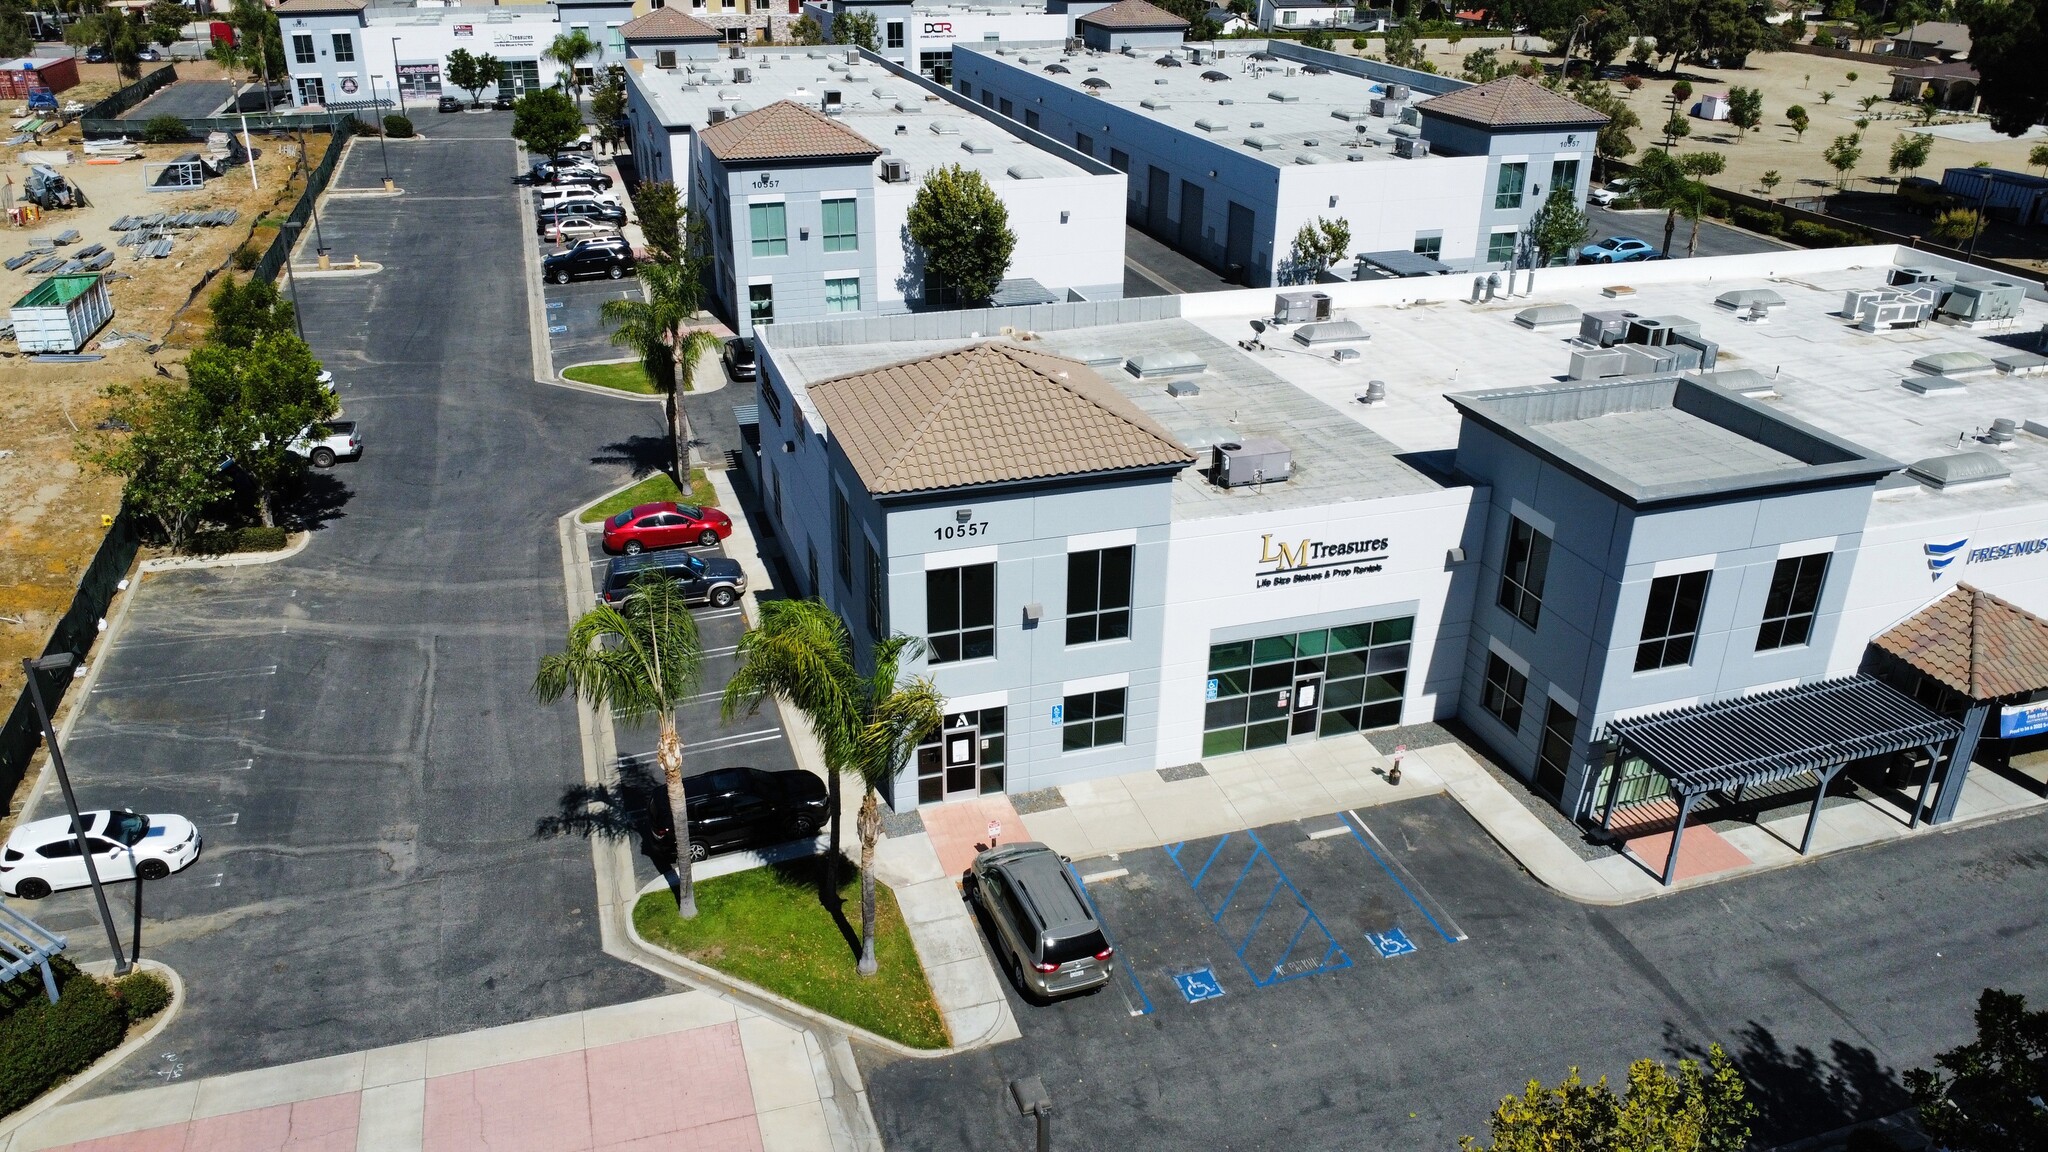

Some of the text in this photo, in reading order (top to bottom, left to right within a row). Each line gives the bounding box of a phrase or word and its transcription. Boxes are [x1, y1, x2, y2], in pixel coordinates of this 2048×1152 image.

[752, 180, 779, 189] 10557
[934, 522, 989, 540] 10557
[1310, 538, 1389, 559] Treasures
[1970, 538, 2048, 562] FRESENIUS
[1257, 564, 1383, 589] Life Size Statues & Prop Rentals
[956, 712, 969, 728] A
